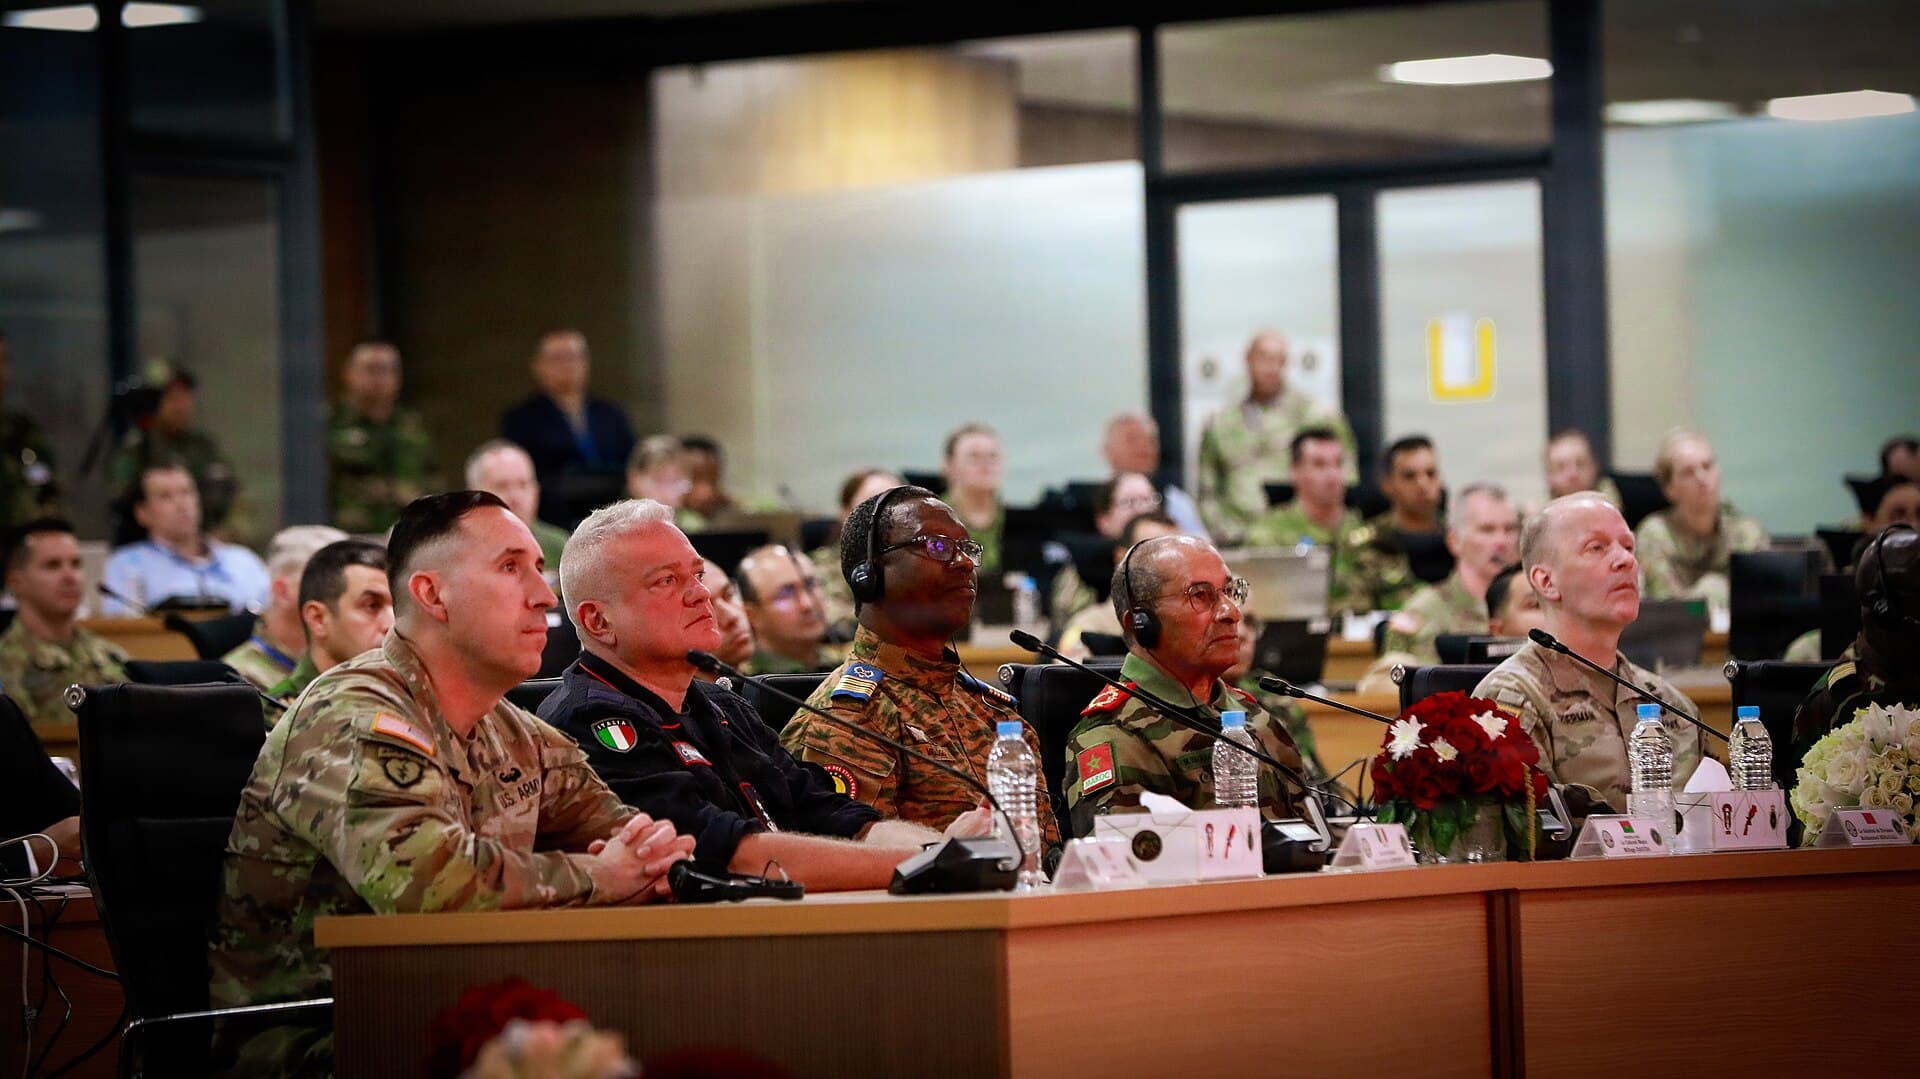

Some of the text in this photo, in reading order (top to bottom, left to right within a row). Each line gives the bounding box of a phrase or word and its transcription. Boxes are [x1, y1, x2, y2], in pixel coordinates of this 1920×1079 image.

[597, 720, 627, 730] ITALIA
[1084, 771, 1111, 787] MAROC
[497, 792, 517, 809] U.S.
